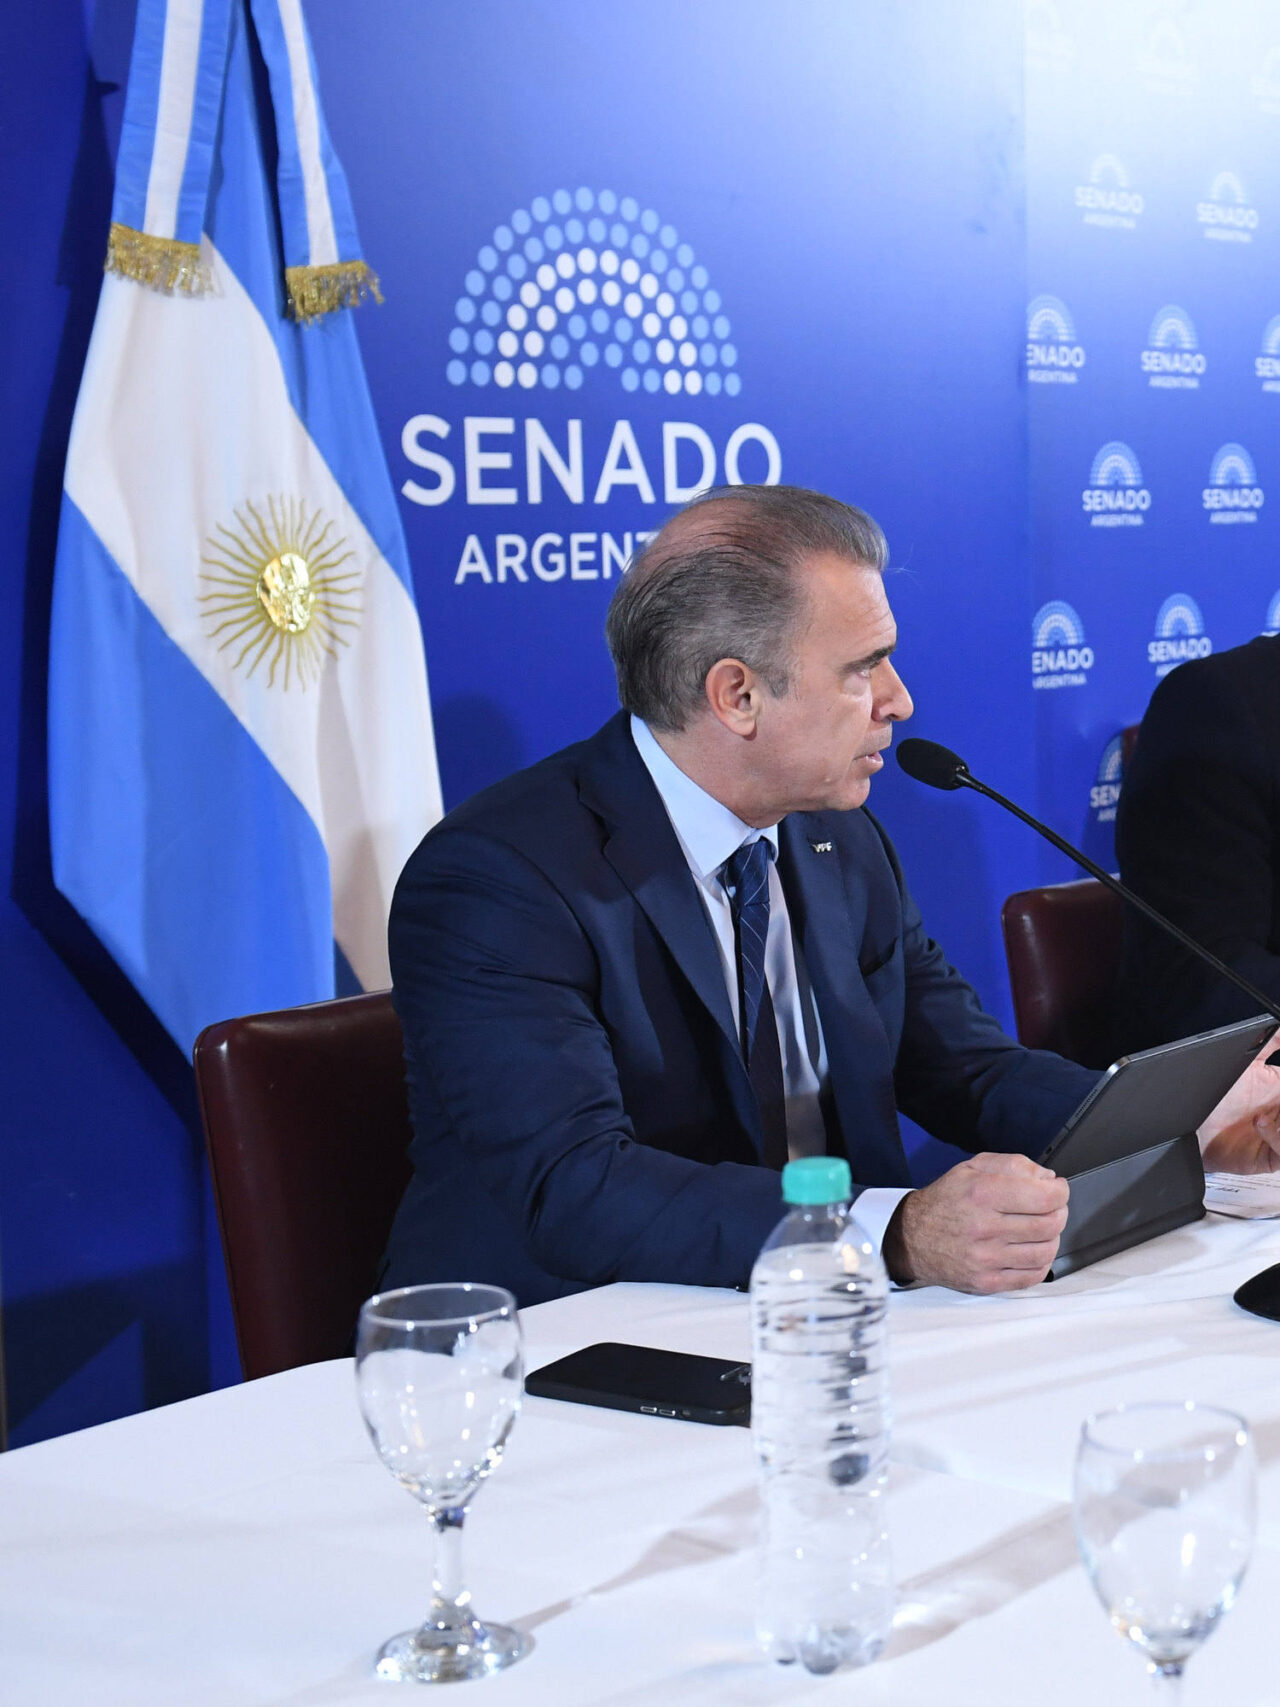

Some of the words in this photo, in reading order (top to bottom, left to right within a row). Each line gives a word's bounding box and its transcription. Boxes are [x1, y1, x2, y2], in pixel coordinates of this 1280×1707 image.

[1075, 186, 1143, 214] SENADO
[1197, 202, 1258, 228] SENADO
[1027, 344, 1085, 368] ENADO
[1141, 351, 1206, 374] SENADO
[401, 413, 782, 506] SENADO
[1082, 489, 1151, 512] SENADO
[1202, 488, 1264, 510] SENADO
[454, 531, 660, 585] ARGEN
[1032, 647, 1094, 674] ENADO
[1148, 637, 1212, 663] SENADO
